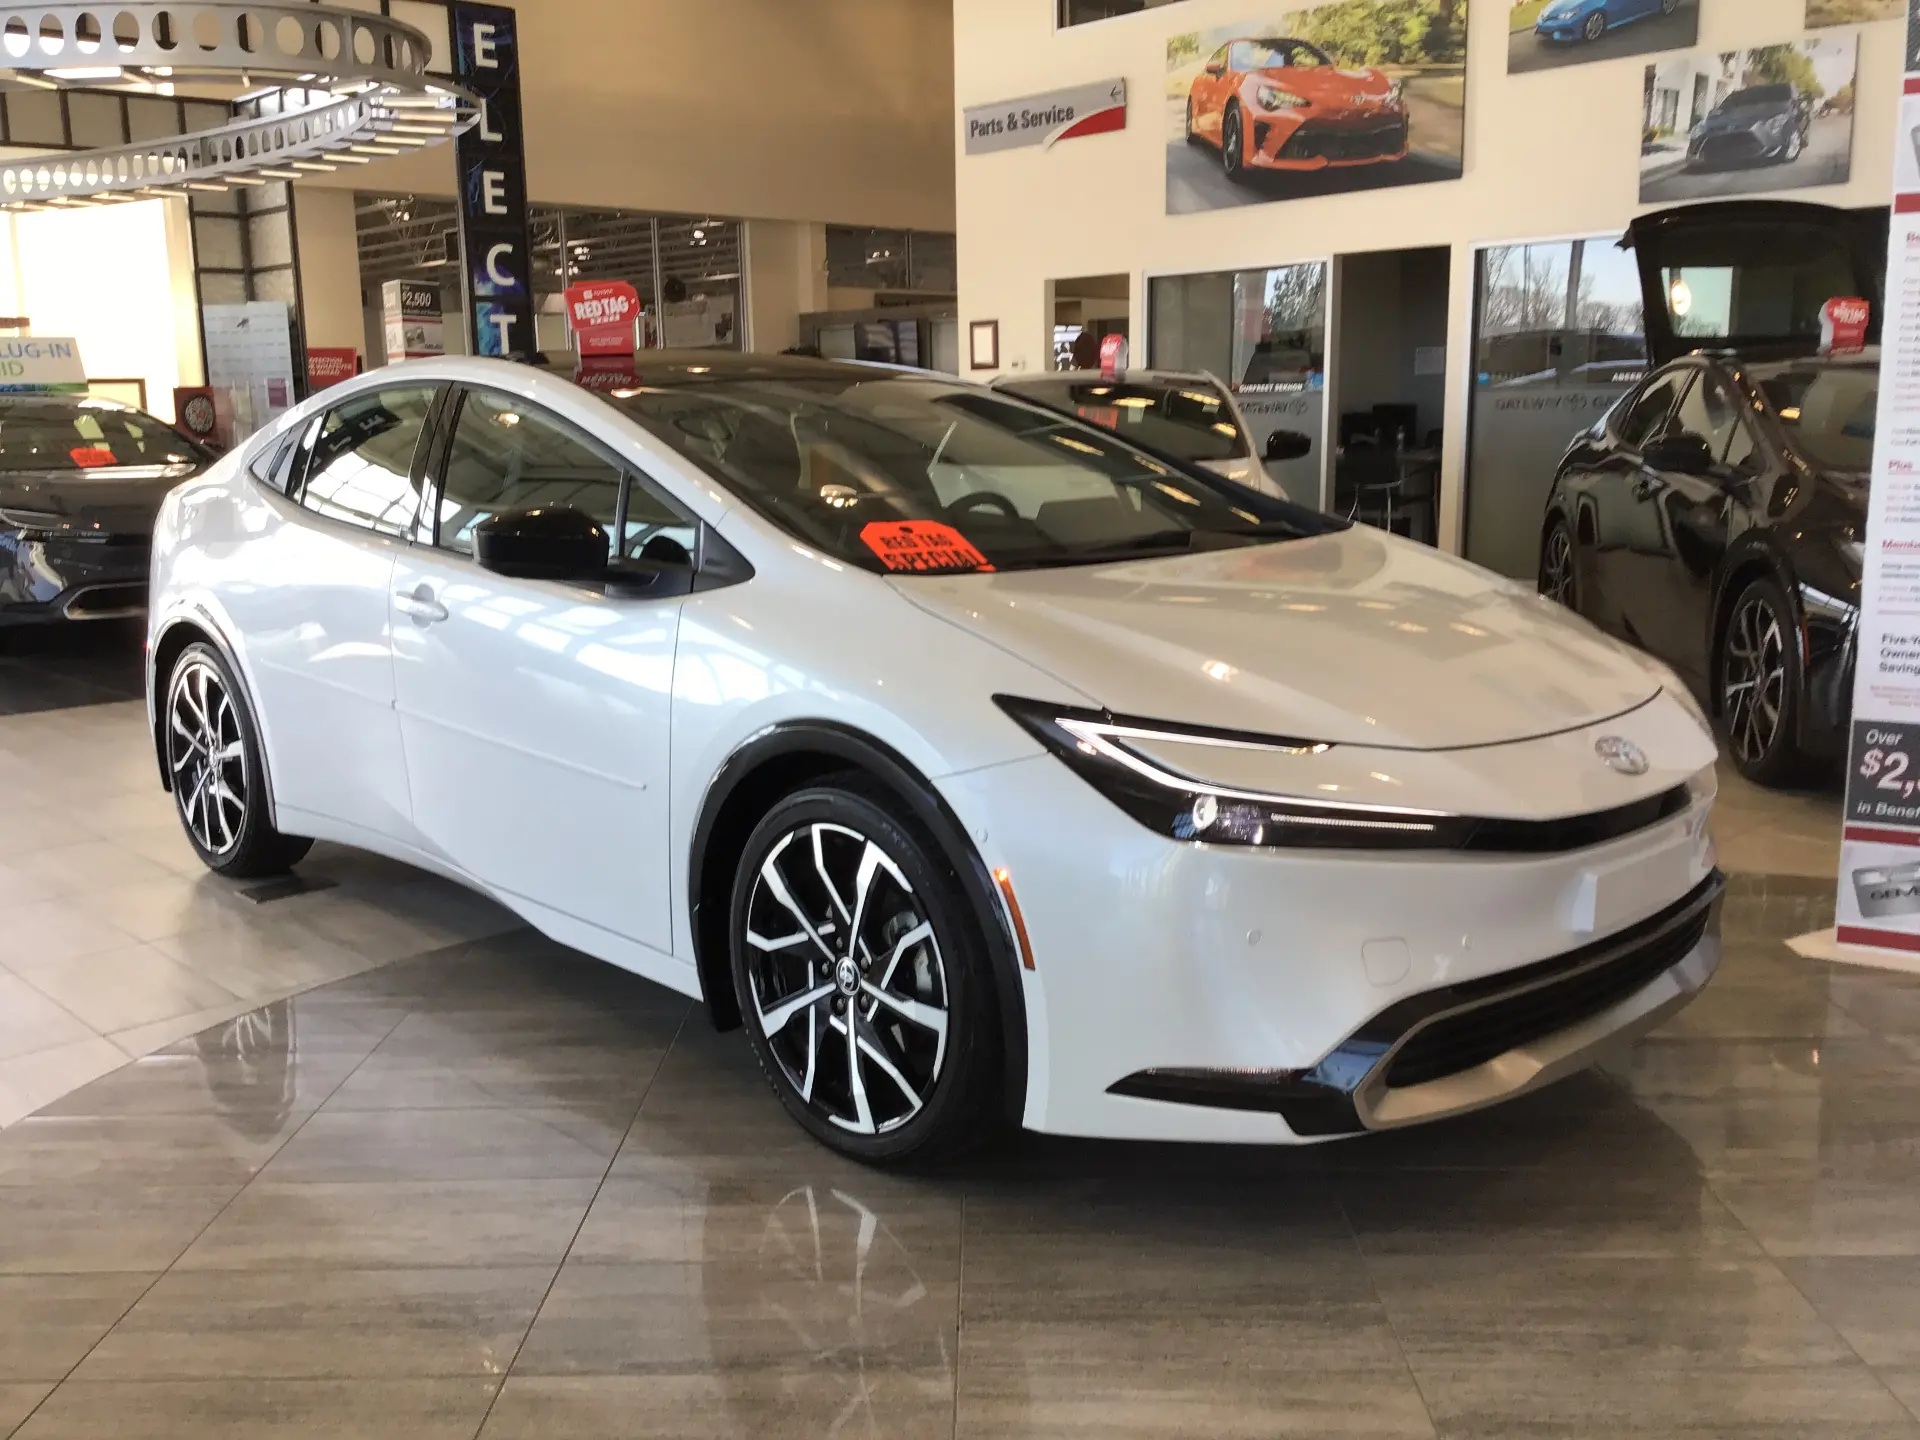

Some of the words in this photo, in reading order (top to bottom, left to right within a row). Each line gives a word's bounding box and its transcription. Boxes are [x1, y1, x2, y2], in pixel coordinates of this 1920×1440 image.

[970, 117, 1004, 138] Parts
[1007, 111, 1018, 131] &
[1021, 105, 1075, 129] Service
[1866, 729, 1903, 746] Over
[1860, 747, 1920, 799] $2,
[1857, 801, 1871, 815] in
